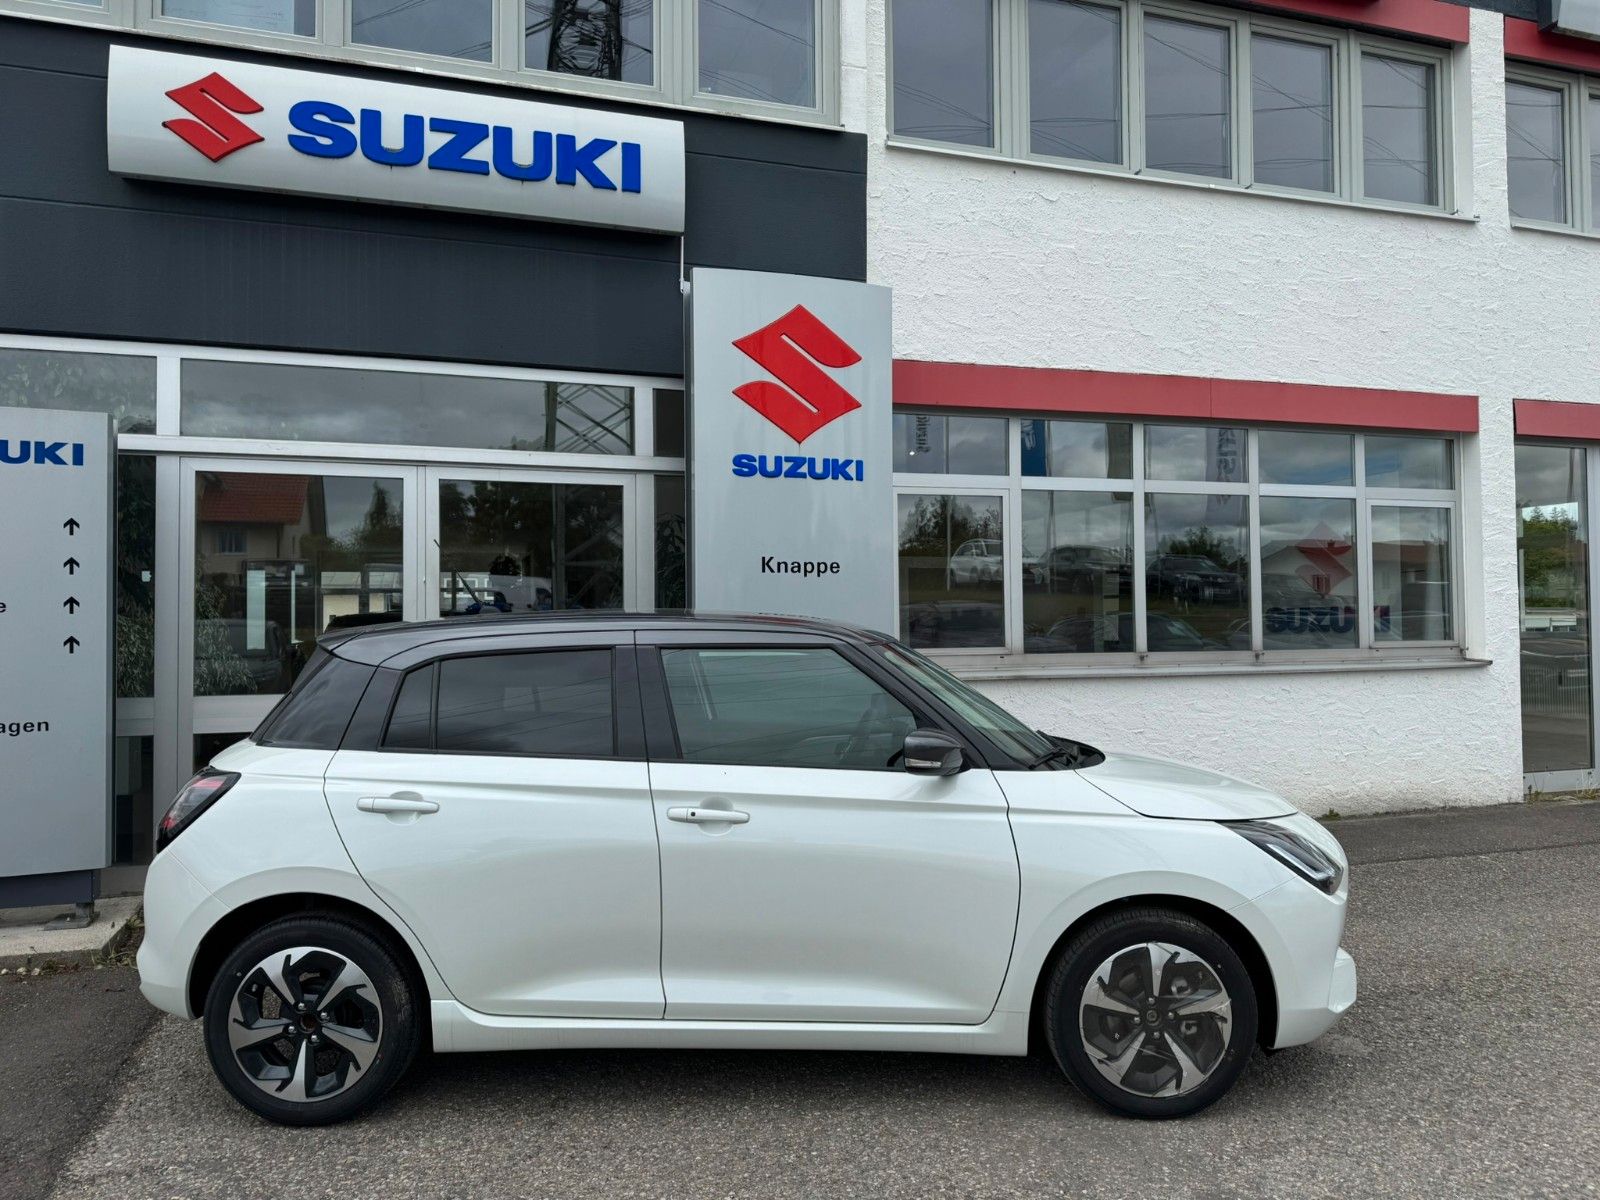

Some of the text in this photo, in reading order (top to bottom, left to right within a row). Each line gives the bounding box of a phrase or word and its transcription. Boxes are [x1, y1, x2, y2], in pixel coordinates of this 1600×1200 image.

[287, 100, 642, 194] SUZUKI
[0, 439, 84, 467] UKI
[732, 453, 864, 482] SUZUKI
[761, 556, 841, 578] Knappe
